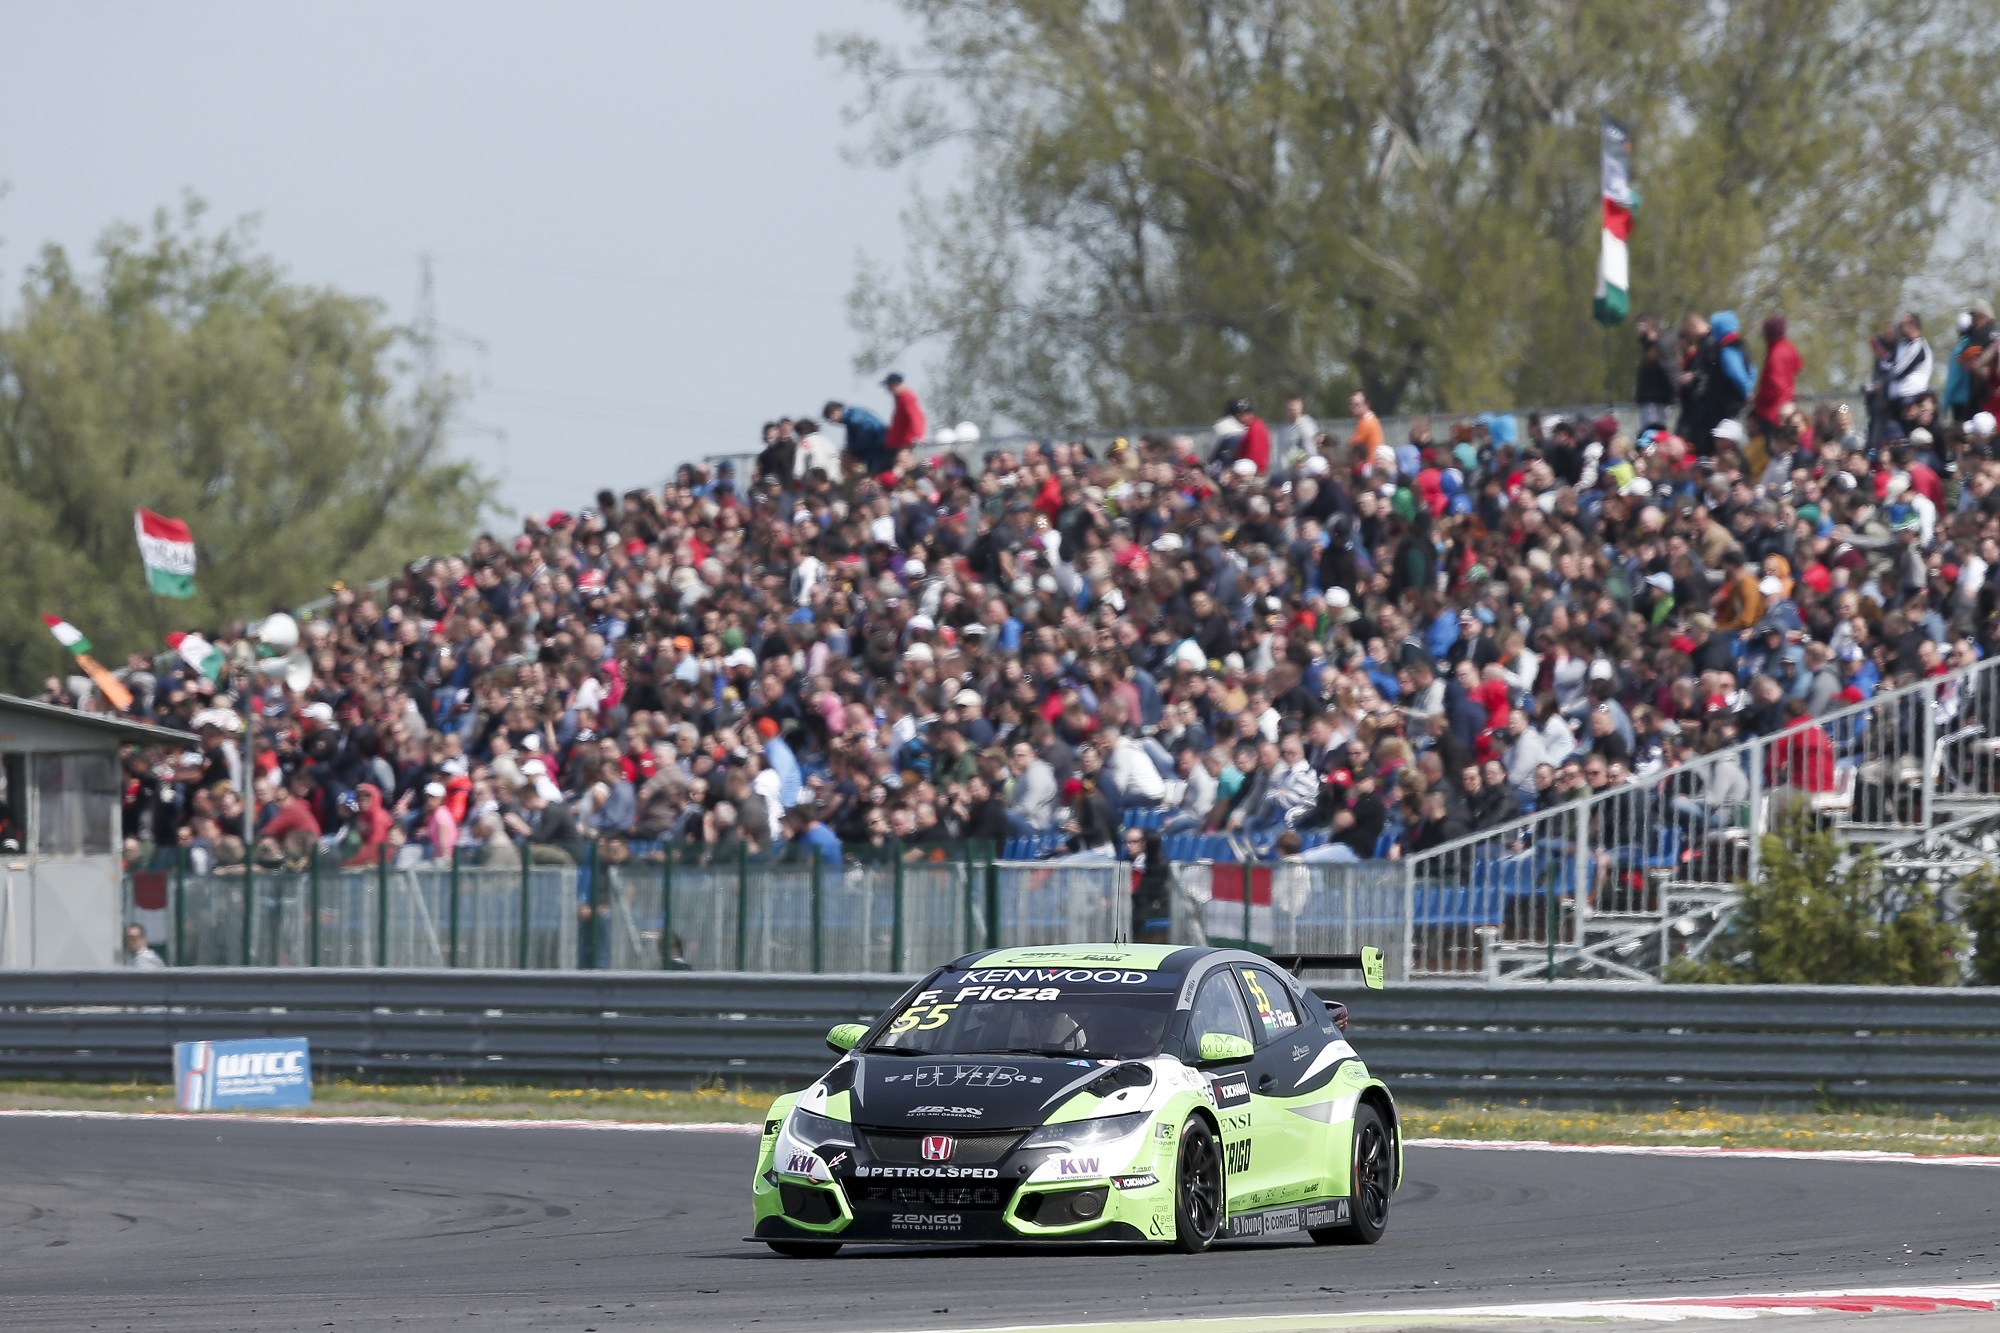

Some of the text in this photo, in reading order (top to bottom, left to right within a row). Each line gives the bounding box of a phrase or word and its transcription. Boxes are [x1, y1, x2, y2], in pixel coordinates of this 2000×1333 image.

[957, 968, 1148, 984] KENWOOD
[911, 985, 1061, 1007] F. Ficza
[1241, 970, 1271, 1013] 55
[889, 1003, 959, 1034] 55
[1201, 1044, 1248, 1054] MUZIX
[216, 1050, 305, 1077] WTCC
[1220, 1081, 1250, 1100] YOKOHAMA
[787, 1154, 818, 1173] KW
[870, 1166, 999, 1179] PETROLSPED
[1060, 1157, 1100, 1175] KW
[1122, 1174, 1157, 1188] YOKOHAMA
[1240, 1216, 1263, 1236] Young
